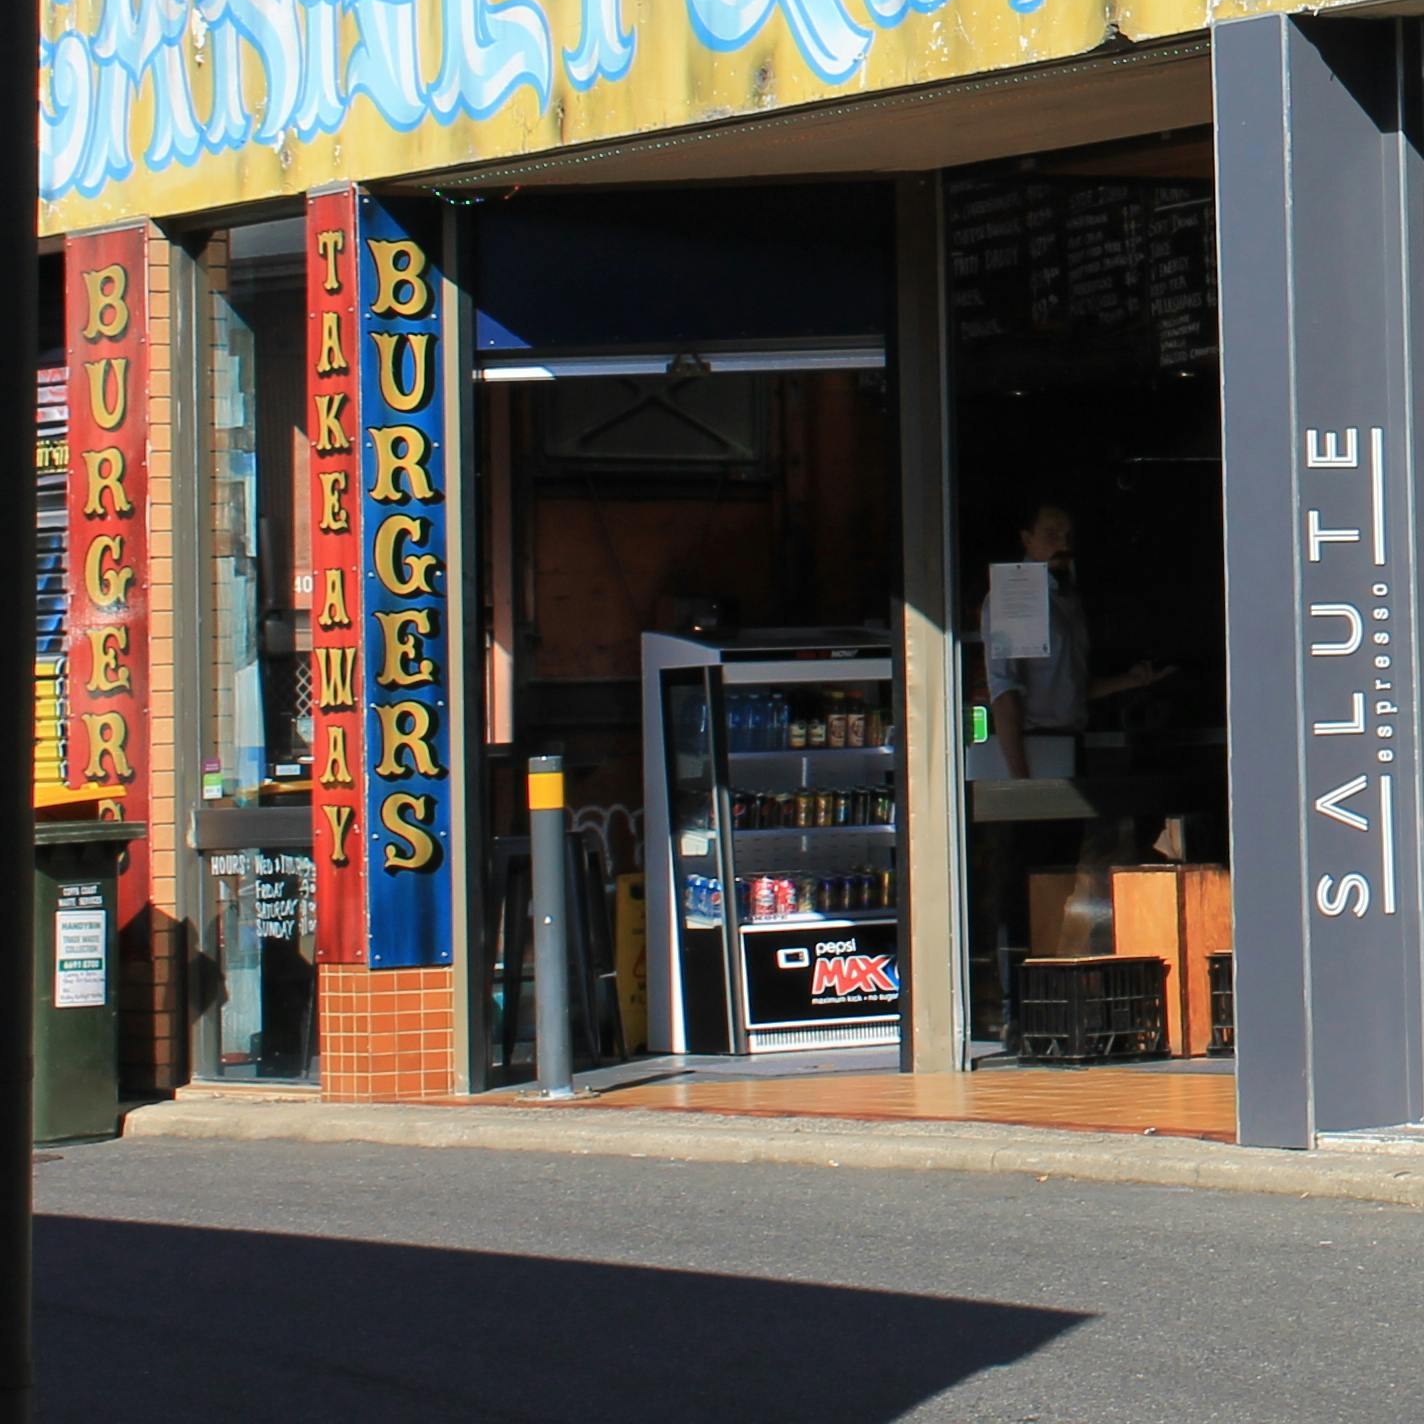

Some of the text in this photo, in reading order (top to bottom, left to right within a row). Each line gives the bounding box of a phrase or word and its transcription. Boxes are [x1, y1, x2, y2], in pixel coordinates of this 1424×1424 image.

[314, 230, 356, 864] TAKE AWAY
[367, 237, 446, 874] BURGERS
[1305, 426, 1370, 919] SALUTE
[1371, 582, 1398, 764] espresso
[255, 918, 296, 940] SUNDAY
[812, 955, 897, 996] MAX
[815, 937, 857, 956] pepsi
